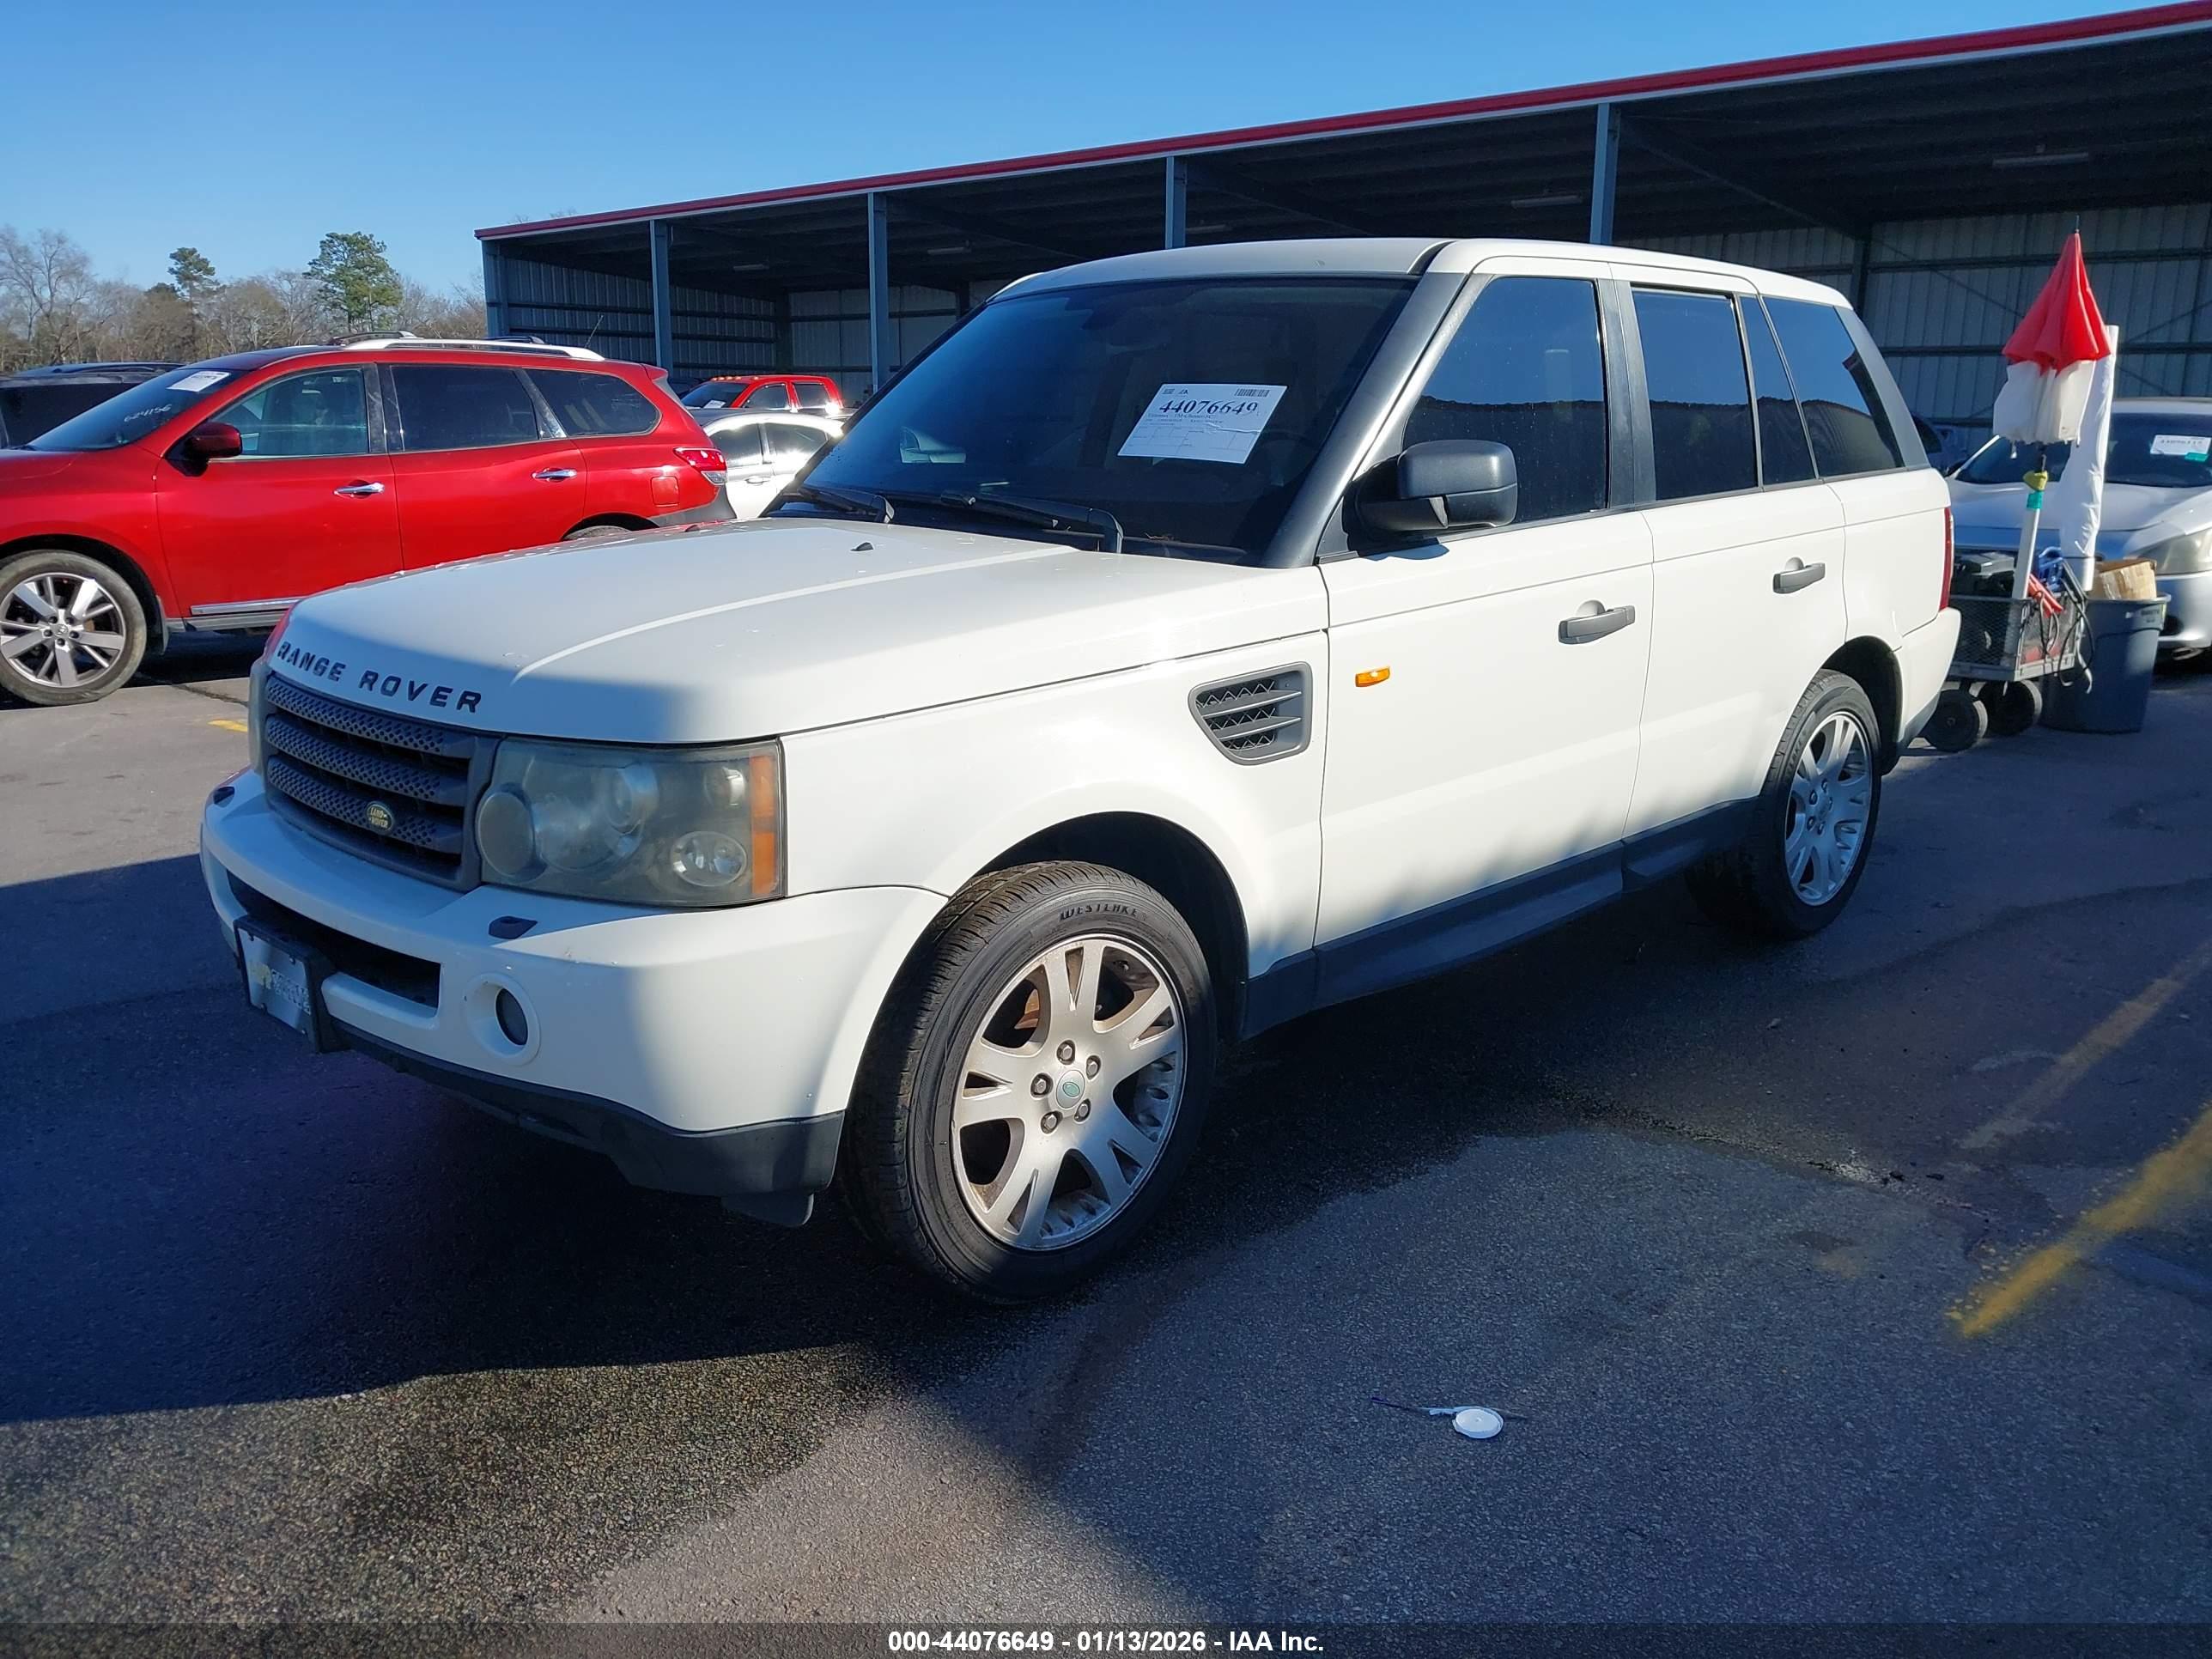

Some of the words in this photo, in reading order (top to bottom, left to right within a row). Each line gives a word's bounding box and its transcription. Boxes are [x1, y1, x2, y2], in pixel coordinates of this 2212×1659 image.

[1159, 399, 1259, 416] 44076649
[276, 641, 346, 681] RANGE
[358, 670, 482, 713] ROVER
